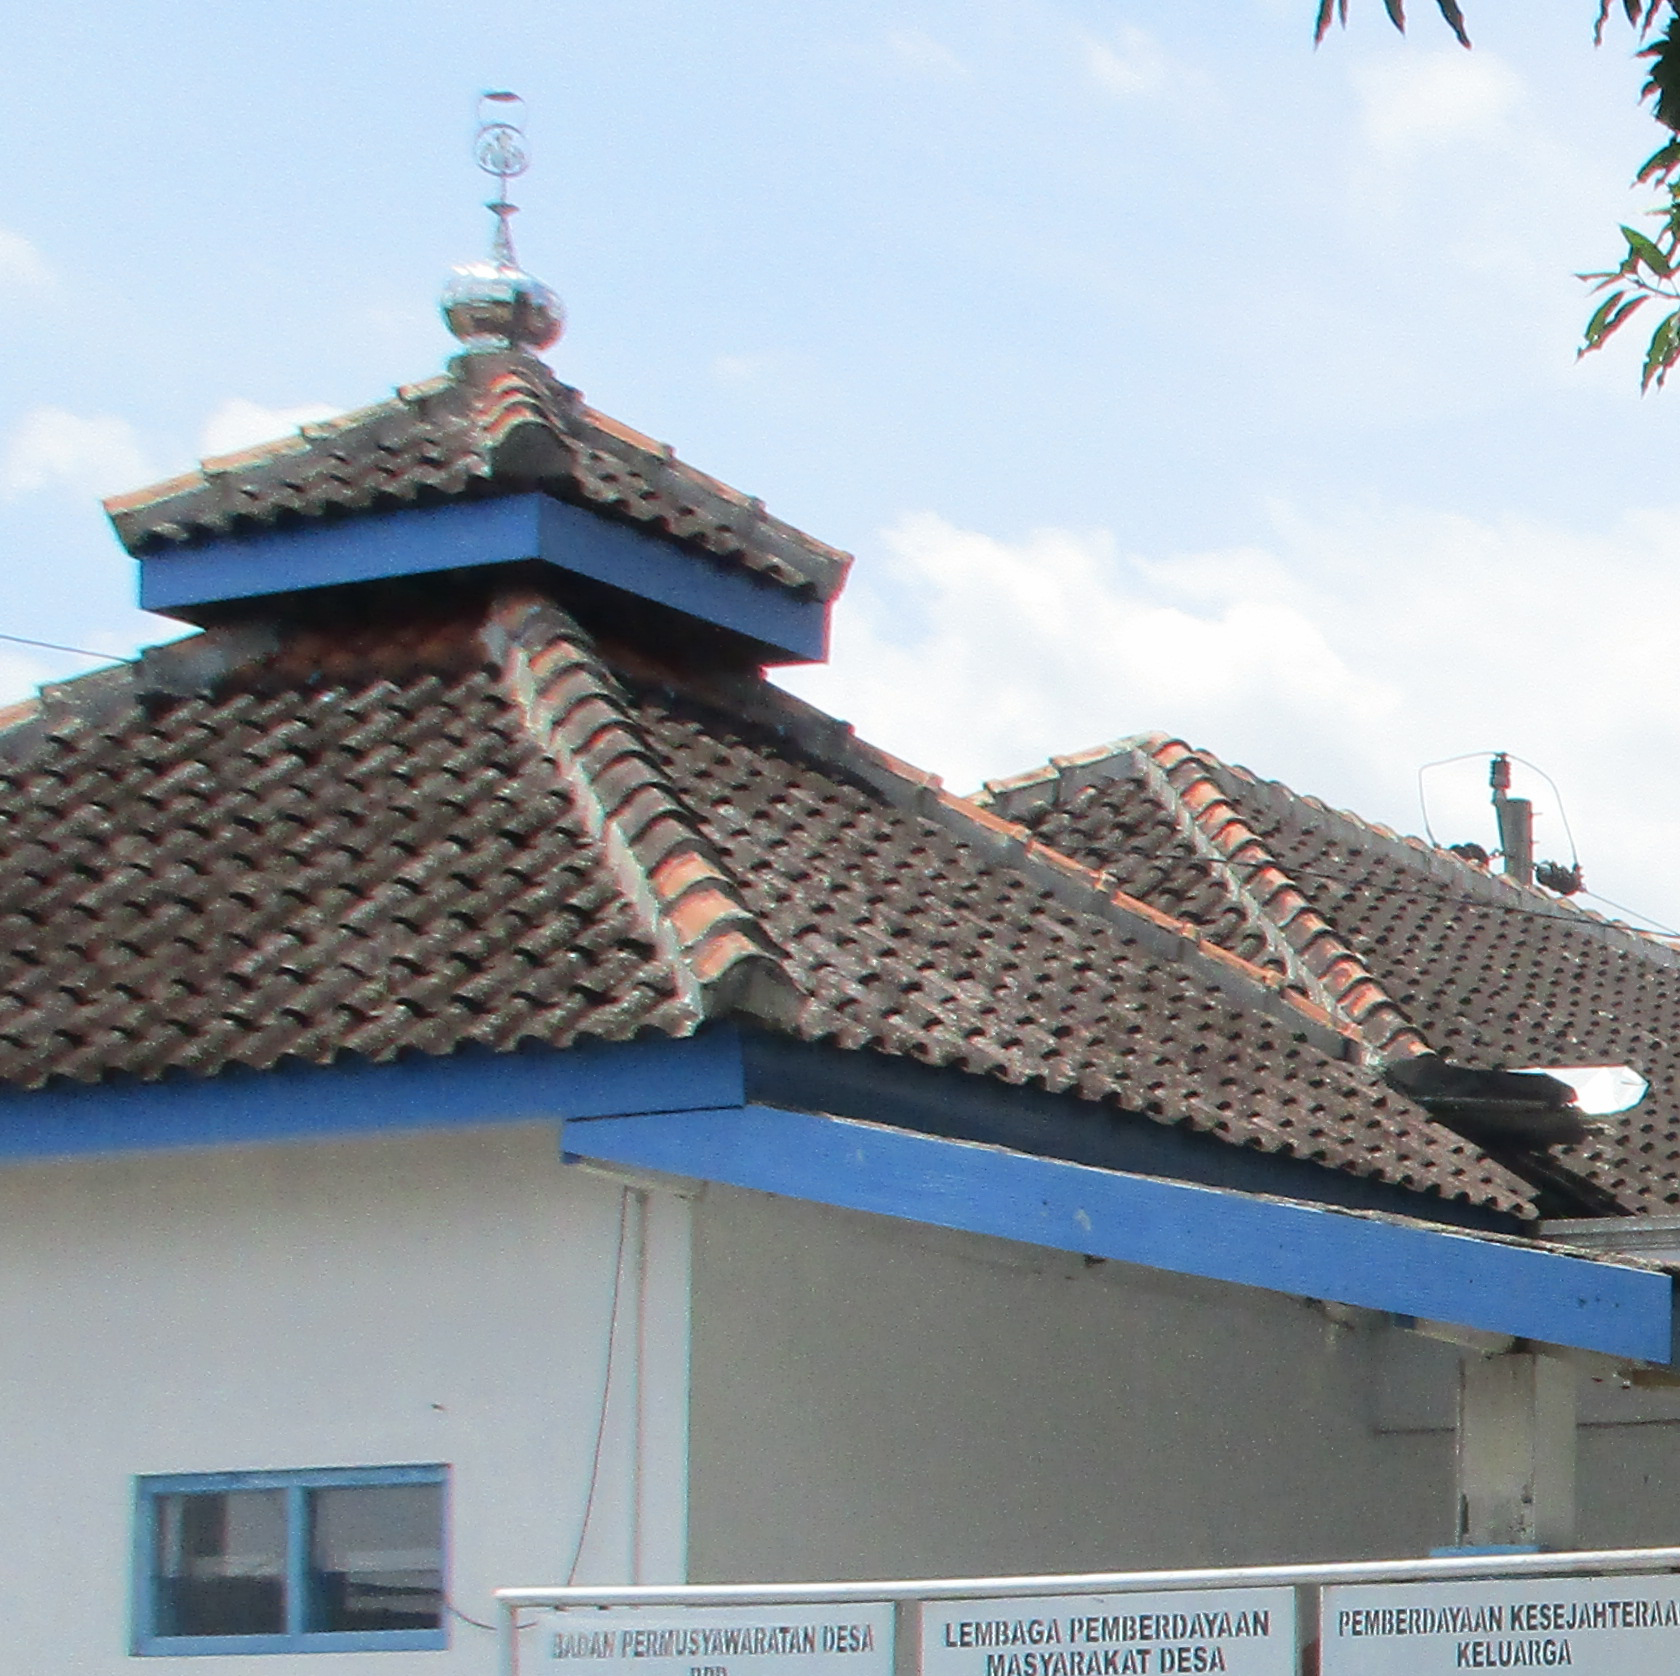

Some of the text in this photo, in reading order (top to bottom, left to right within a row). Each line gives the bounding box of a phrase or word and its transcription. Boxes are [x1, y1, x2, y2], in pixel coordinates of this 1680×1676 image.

[945, 1610, 1269, 1648] LEMBAGA PEMBERDAYAAN
[1338, 1605, 1503, 1637] PEMBERDAYAAN
[621, 1625, 816, 1658] PERMUSYAWARATAN
[822, 1624, 874, 1654] DESA
[1457, 1638, 1572, 1668] KELUARGA
[1160, 1646, 1225, 1674] DESA
